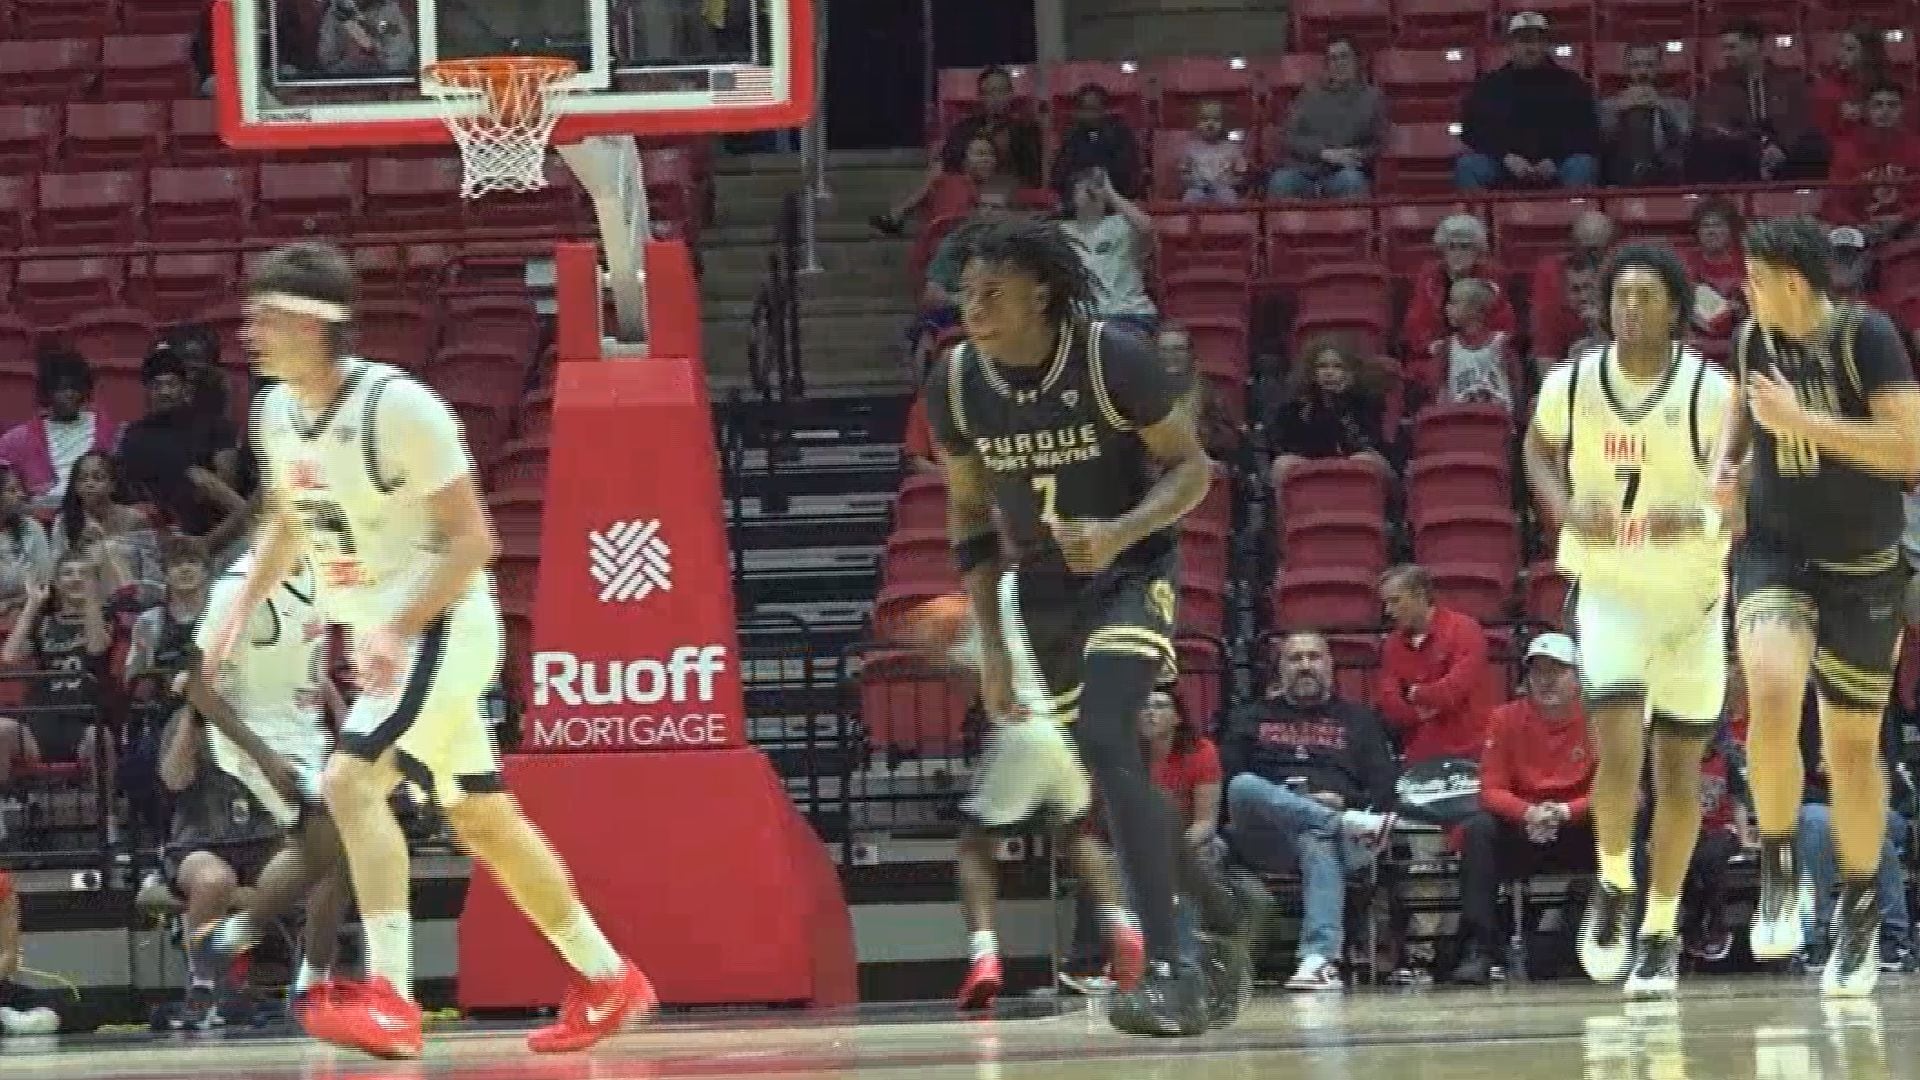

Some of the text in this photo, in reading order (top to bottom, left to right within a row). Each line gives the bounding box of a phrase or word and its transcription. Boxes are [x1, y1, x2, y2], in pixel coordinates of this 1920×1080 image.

[976, 422, 1098, 453] PURDUE
[1031, 445, 1101, 468] WAYNE
[1031, 474, 1058, 522] 7
[1614, 464, 1641, 516] 7
[532, 646, 727, 706] Ruoff
[534, 713, 727, 746] MORTGAGE
